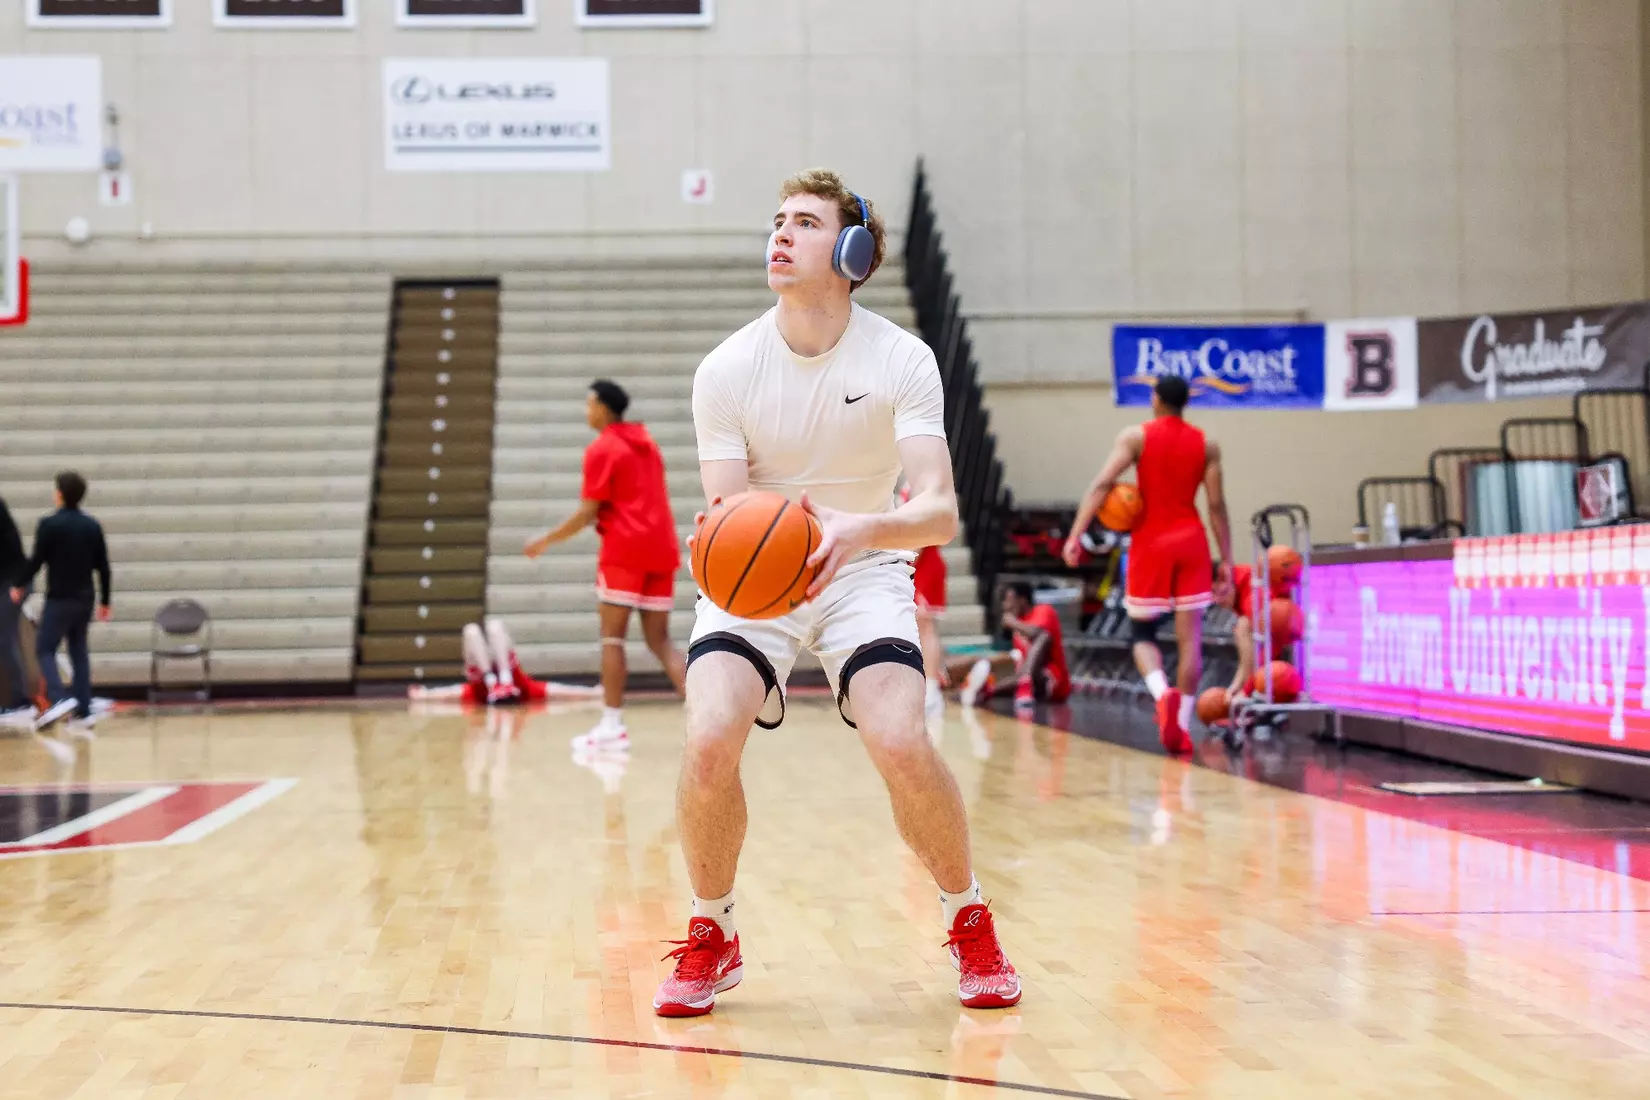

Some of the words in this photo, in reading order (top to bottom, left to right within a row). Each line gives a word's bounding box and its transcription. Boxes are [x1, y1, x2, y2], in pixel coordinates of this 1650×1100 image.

[437, 82, 556, 101] LEXUS
[393, 122, 458, 140] LEXUS
[465, 122, 491, 139] OF
[690, 176, 706, 199] J
[1135, 337, 1297, 379] BayCoast
[1345, 331, 1397, 398] B
[1461, 315, 1607, 401] Graduate
[1358, 585, 1445, 691] Brown
[1449, 585, 1633, 741] University
